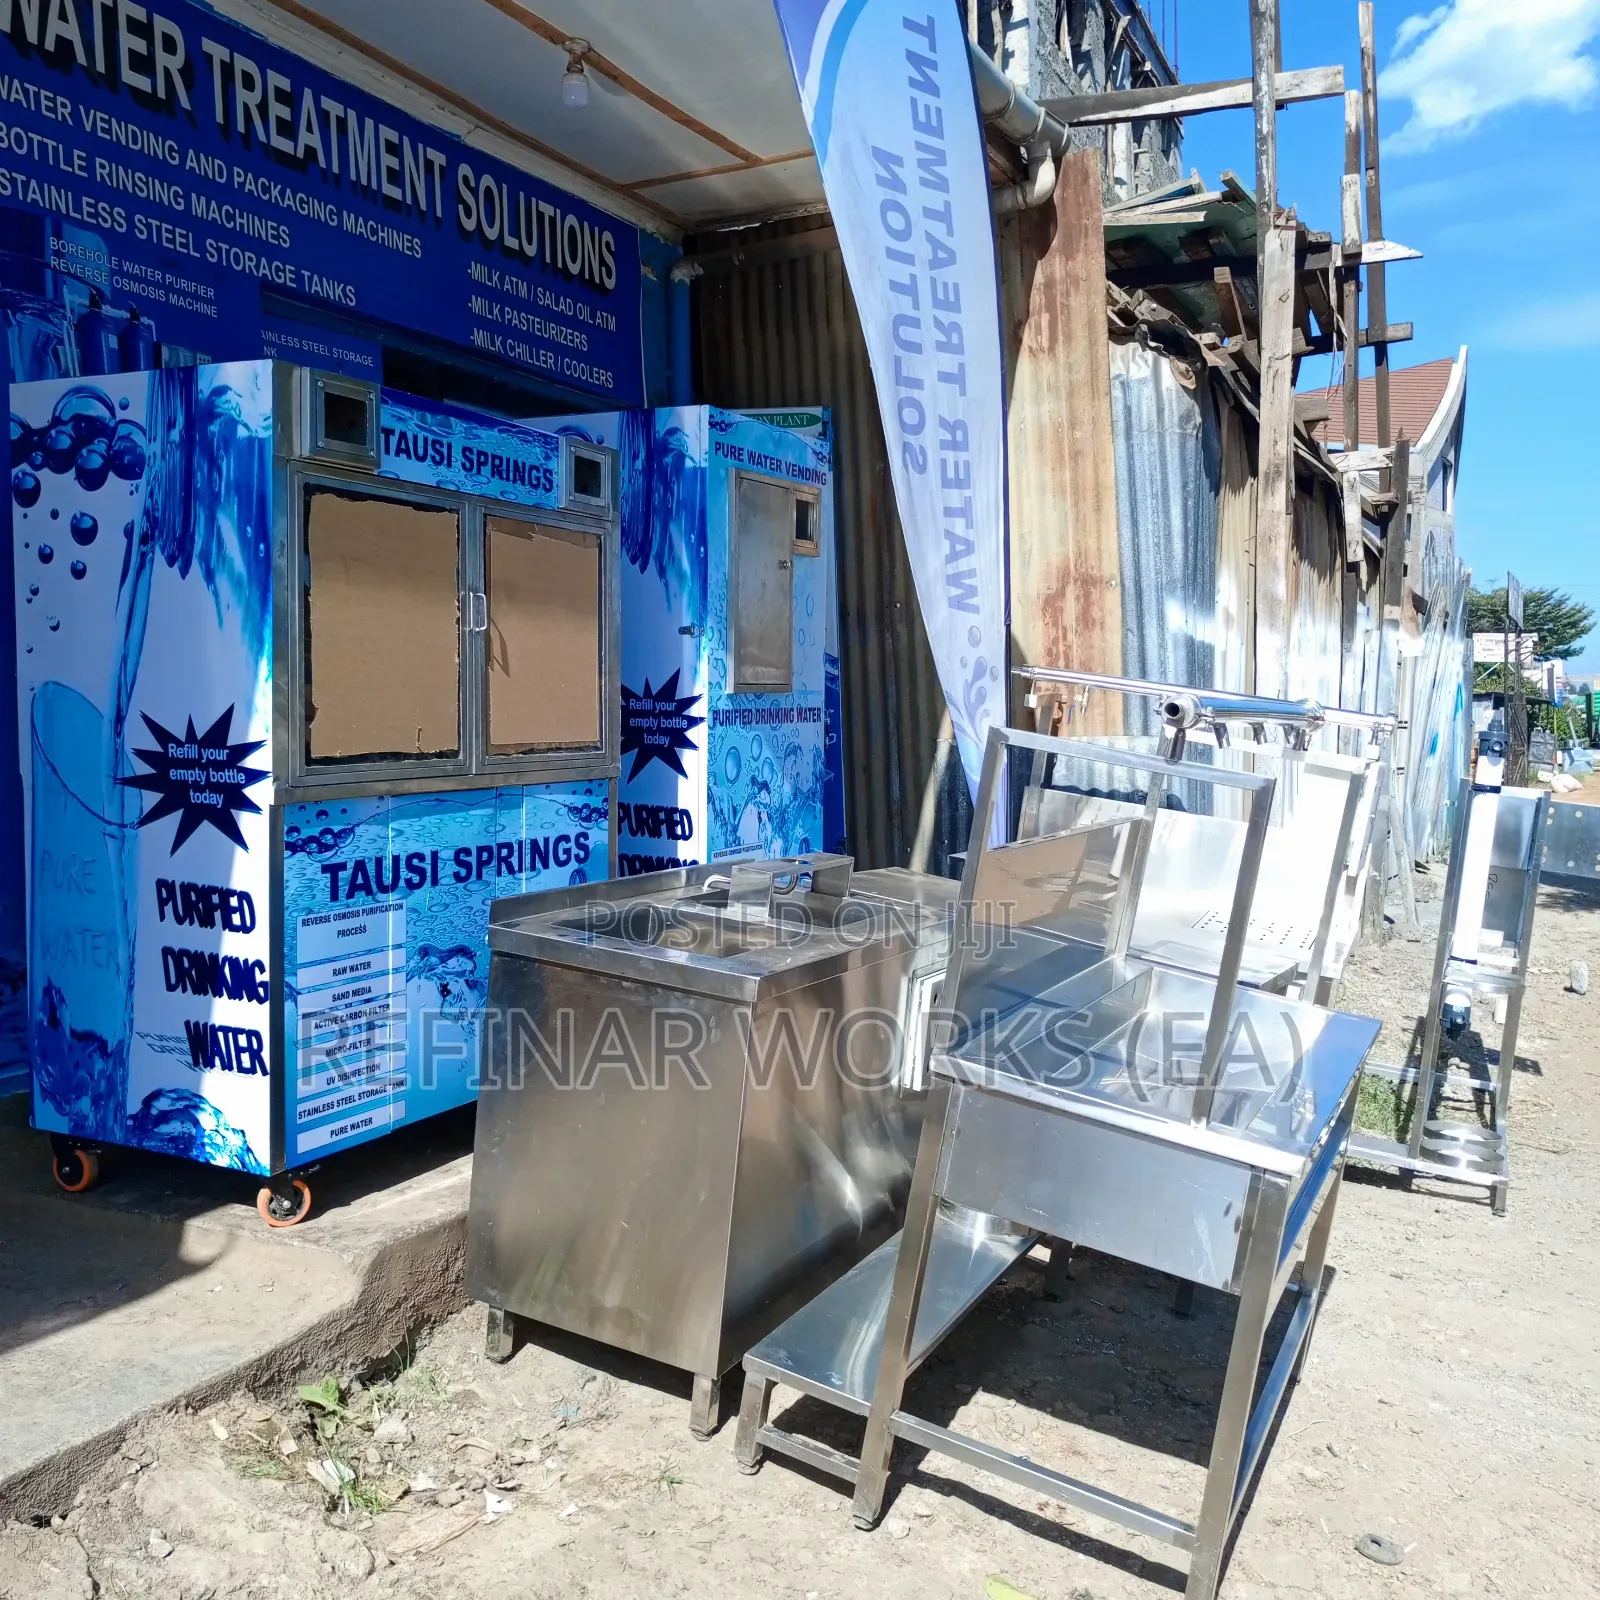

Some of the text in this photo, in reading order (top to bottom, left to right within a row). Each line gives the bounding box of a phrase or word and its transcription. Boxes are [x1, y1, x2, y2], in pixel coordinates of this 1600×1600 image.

[202, 36, 446, 218] TREATMENT
[457, 163, 616, 290] SOLUTIONS
[79, 104, 180, 166] VENDING
[185, 148, 227, 184] AND
[233, 166, 338, 227] PACKAGING
[343, 209, 422, 258] MACHINES
[95, 157, 185, 211] RINSING
[191, 192, 290, 248] MACHINES
[0, 167, 356, 307] STAINLESS STEEL STORAGE TANKS
[49, 237, 215, 300] BOREHOLE WATER PURIFIER
[50, 256, 218, 318] REVERSE OSMOSIS MACHINE
[503, 274, 528, 300] ATM
[530, 282, 534, 302] /
[536, 287, 574, 316] SALAD
[577, 301, 593, 324] OIL
[595, 307, 616, 333] ATM
[505, 305, 588, 351] PASTEURIZERS
[302, 340, 331, 356] STEEL
[332, 347, 374, 367] STORAGE
[506, 342, 555, 371] CHILLER
[557, 351, 562, 372] /
[563, 357, 614, 389] COOLERS
[773, 414, 810, 426] PLANT
[381, 426, 554, 494] TAUSI SPRINGS
[714, 441, 827, 486] PURE WATER VENDING
[629, 699, 677, 713] Refill your
[712, 707, 822, 727] PURIFIED DRINKING WATER
[629, 716, 688, 730] empty bottle
[168, 743, 230, 763] Refill your
[644, 733, 670, 748] today
[169, 767, 246, 785] empty bottle
[189, 789, 224, 808] today
[321, 831, 590, 902] TAUSI SPRINGS
[155, 878, 256, 935] PURIFIED
[301, 902, 404, 928] REVERSE OSMOSIS PURIFICATION
[337, 924, 367, 939] PROCESS
[161, 946, 269, 1005] DRINKING
[332, 961, 372, 977] RAW WATER
[332, 986, 373, 1002] SAND MEDIA
[314, 1003, 391, 1030] ACTIVE CARBON FILTER
[184, 1019, 270, 1077] WATER
[326, 1075, 336, 1085] UV
[298, 1102, 335, 1120] STAINLESS
[336, 1094, 356, 1108] STEEL
[357, 1084, 388, 1101] STORAGE
[330, 1117, 373, 1139] PURE WATER
